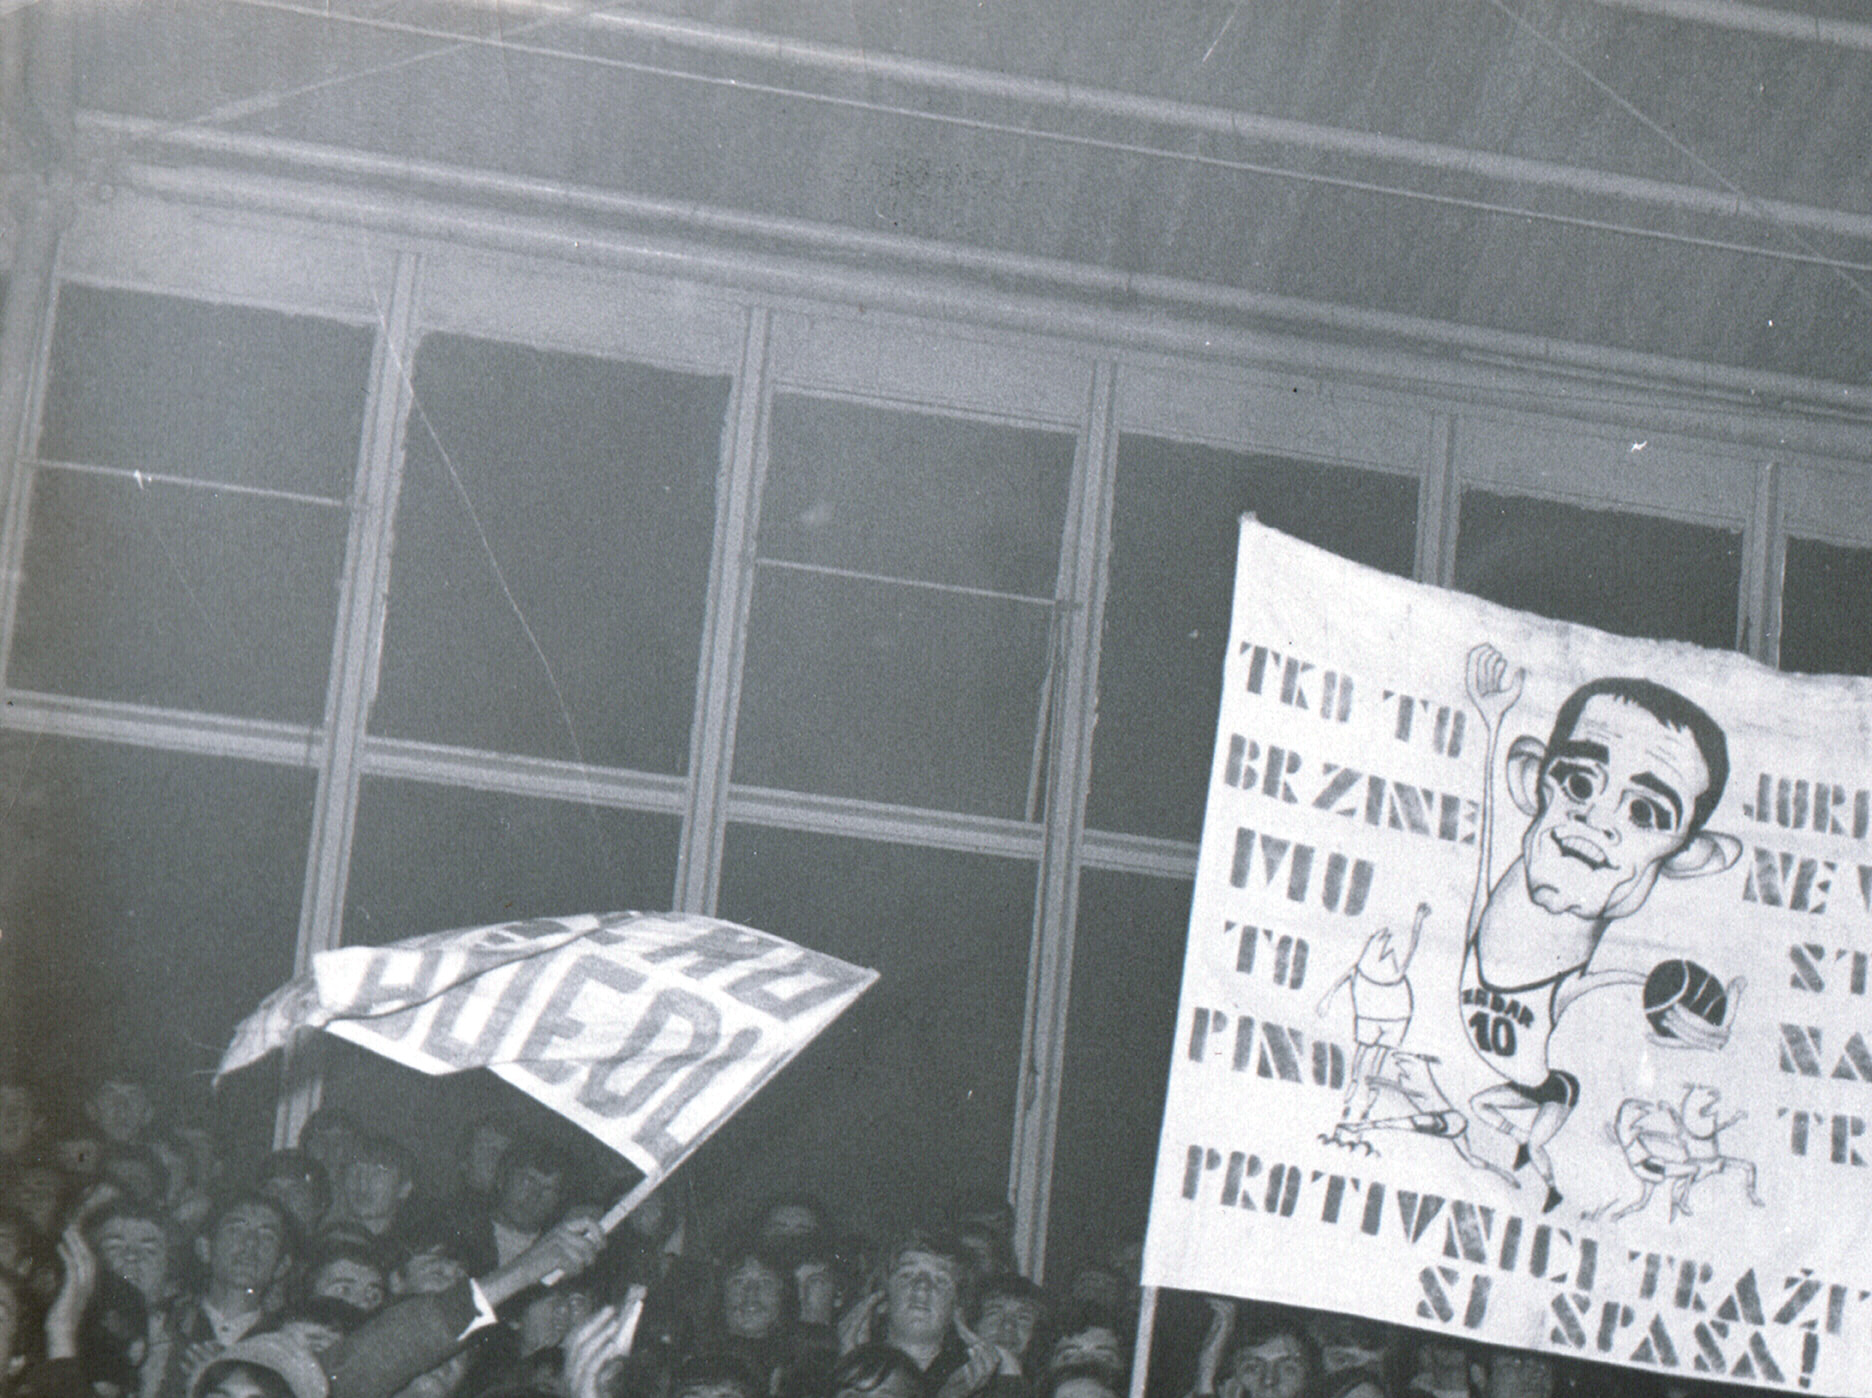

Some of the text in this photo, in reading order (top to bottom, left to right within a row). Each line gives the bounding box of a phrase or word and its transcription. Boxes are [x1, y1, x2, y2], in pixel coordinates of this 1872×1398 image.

[1240, 641, 1467, 759] TKO TO
[1224, 732, 1480, 845] BRZINE
[1743, 772, 1870, 840] JURI
[1742, 845, 1838, 915] NE
[1224, 919, 1310, 990] TO
[1188, 1006, 1345, 1091] PINO
[1468, 1010, 1518, 1057] 10
[1182, 1144, 1600, 1292] PROTIVNICI
[1416, 1265, 1493, 1330] SI
